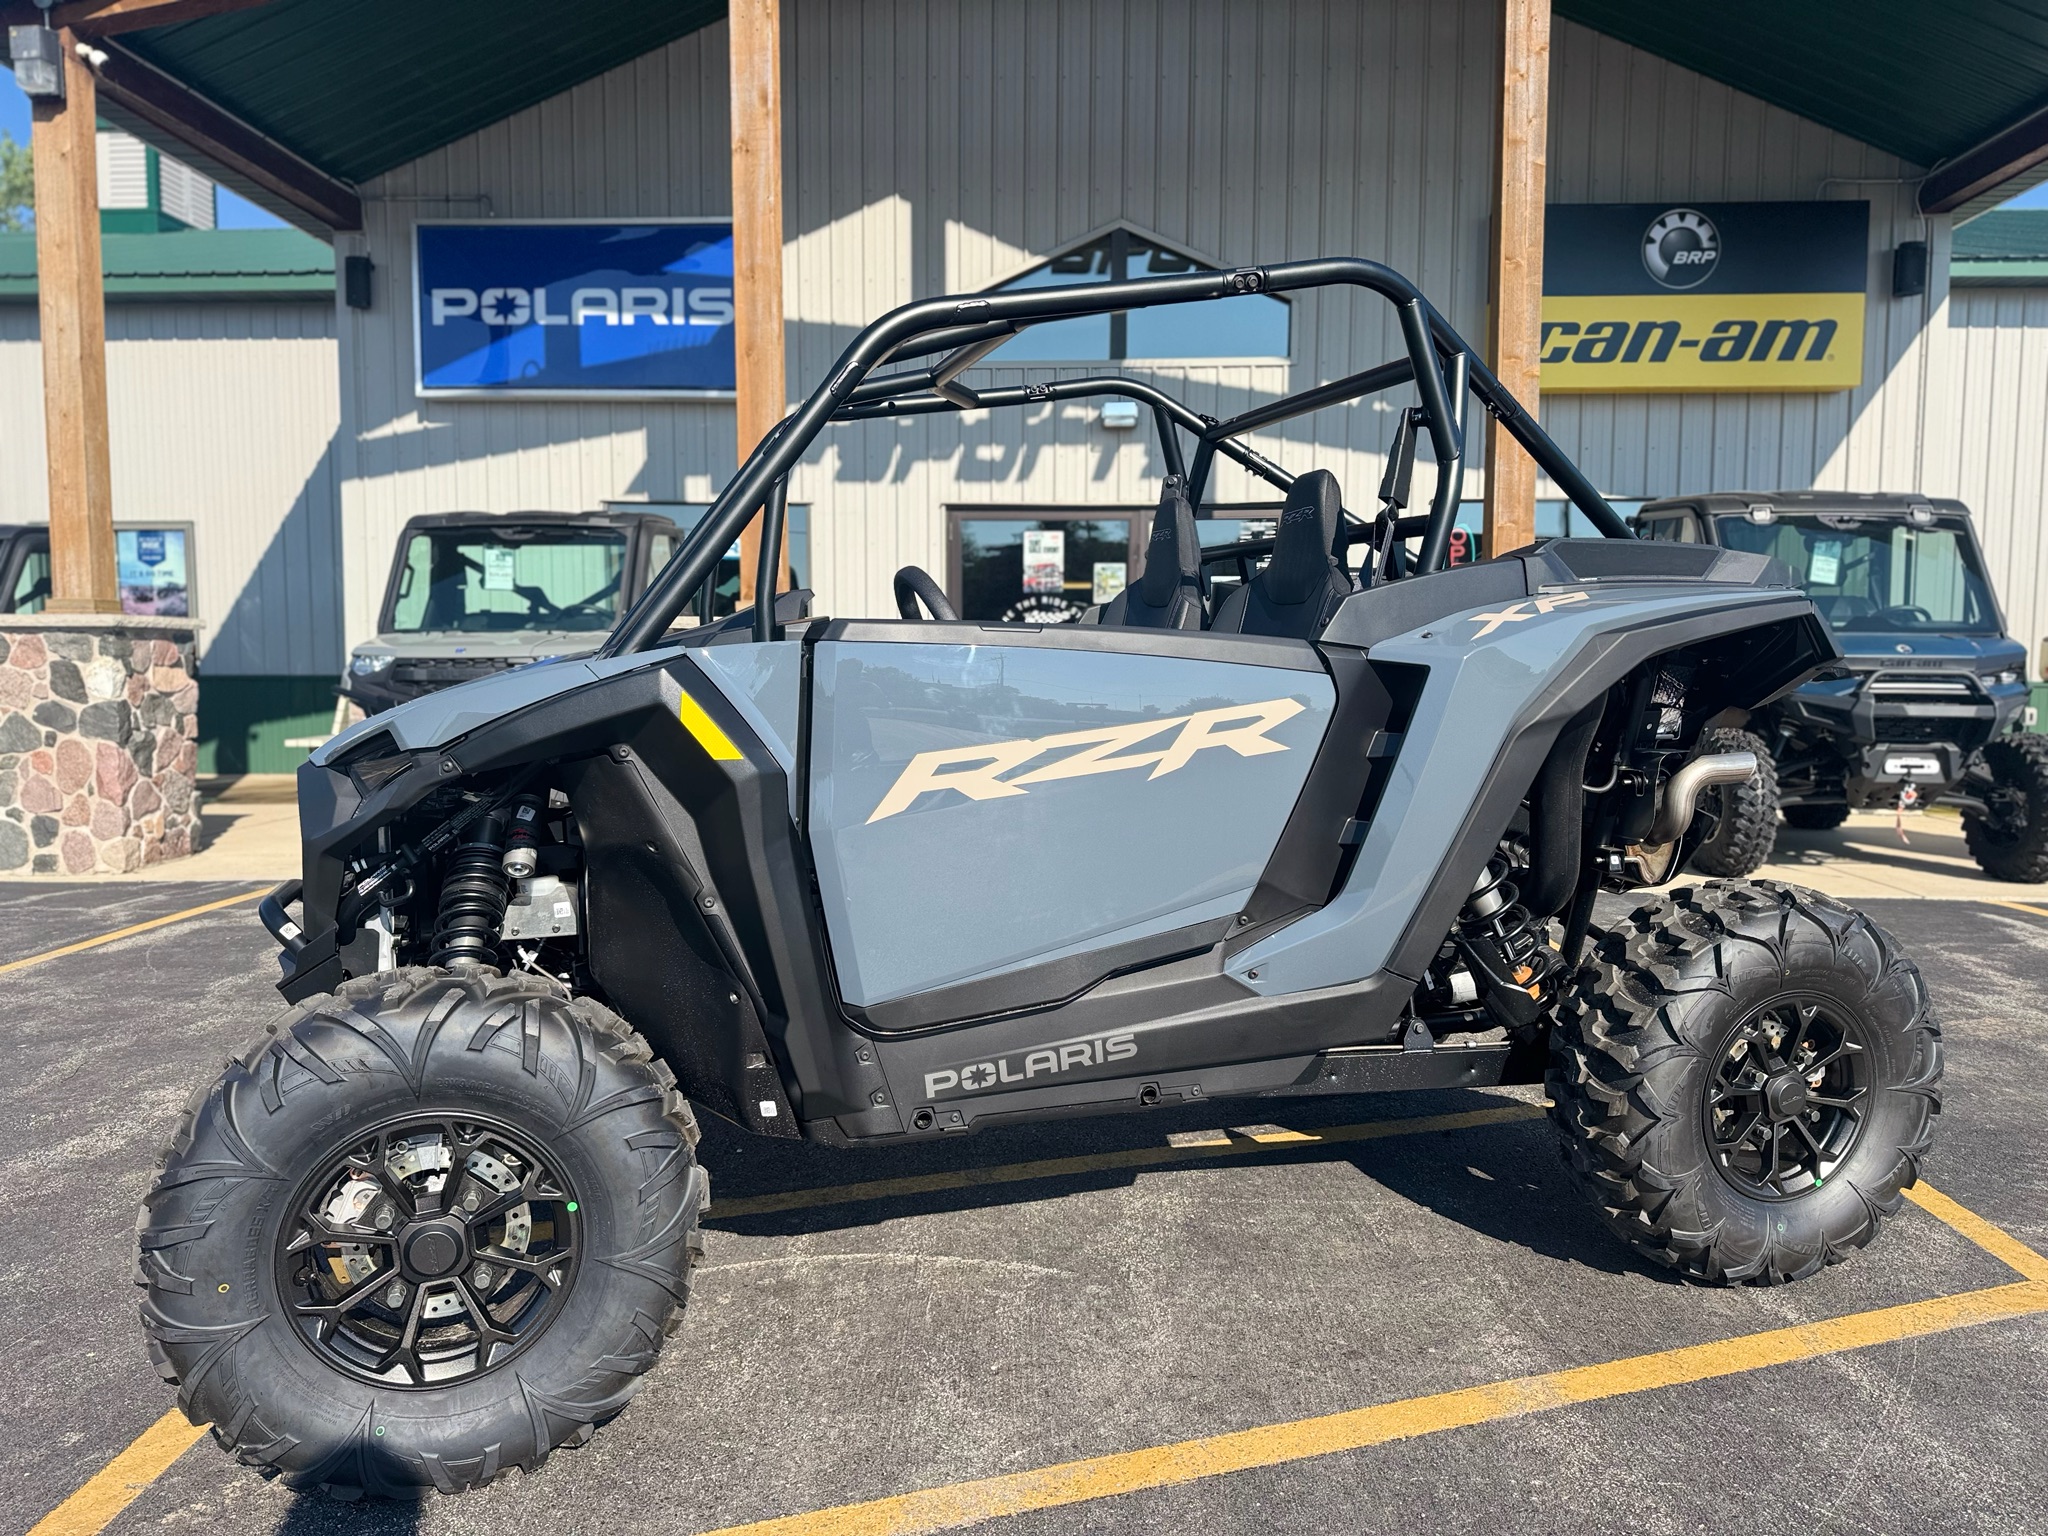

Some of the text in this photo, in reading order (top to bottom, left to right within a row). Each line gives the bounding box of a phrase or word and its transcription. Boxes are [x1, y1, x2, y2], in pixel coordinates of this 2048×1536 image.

[1672, 251, 1717, 265] BRP
[431, 288, 734, 326] POLARIS
[1540, 319, 1838, 363] can-am
[1281, 506, 1315, 528] RZR
[1450, 528, 1467, 567] OP
[1467, 591, 1590, 641] XP
[864, 698, 1306, 825] RZR
[924, 1033, 1138, 1099] POLARIS
